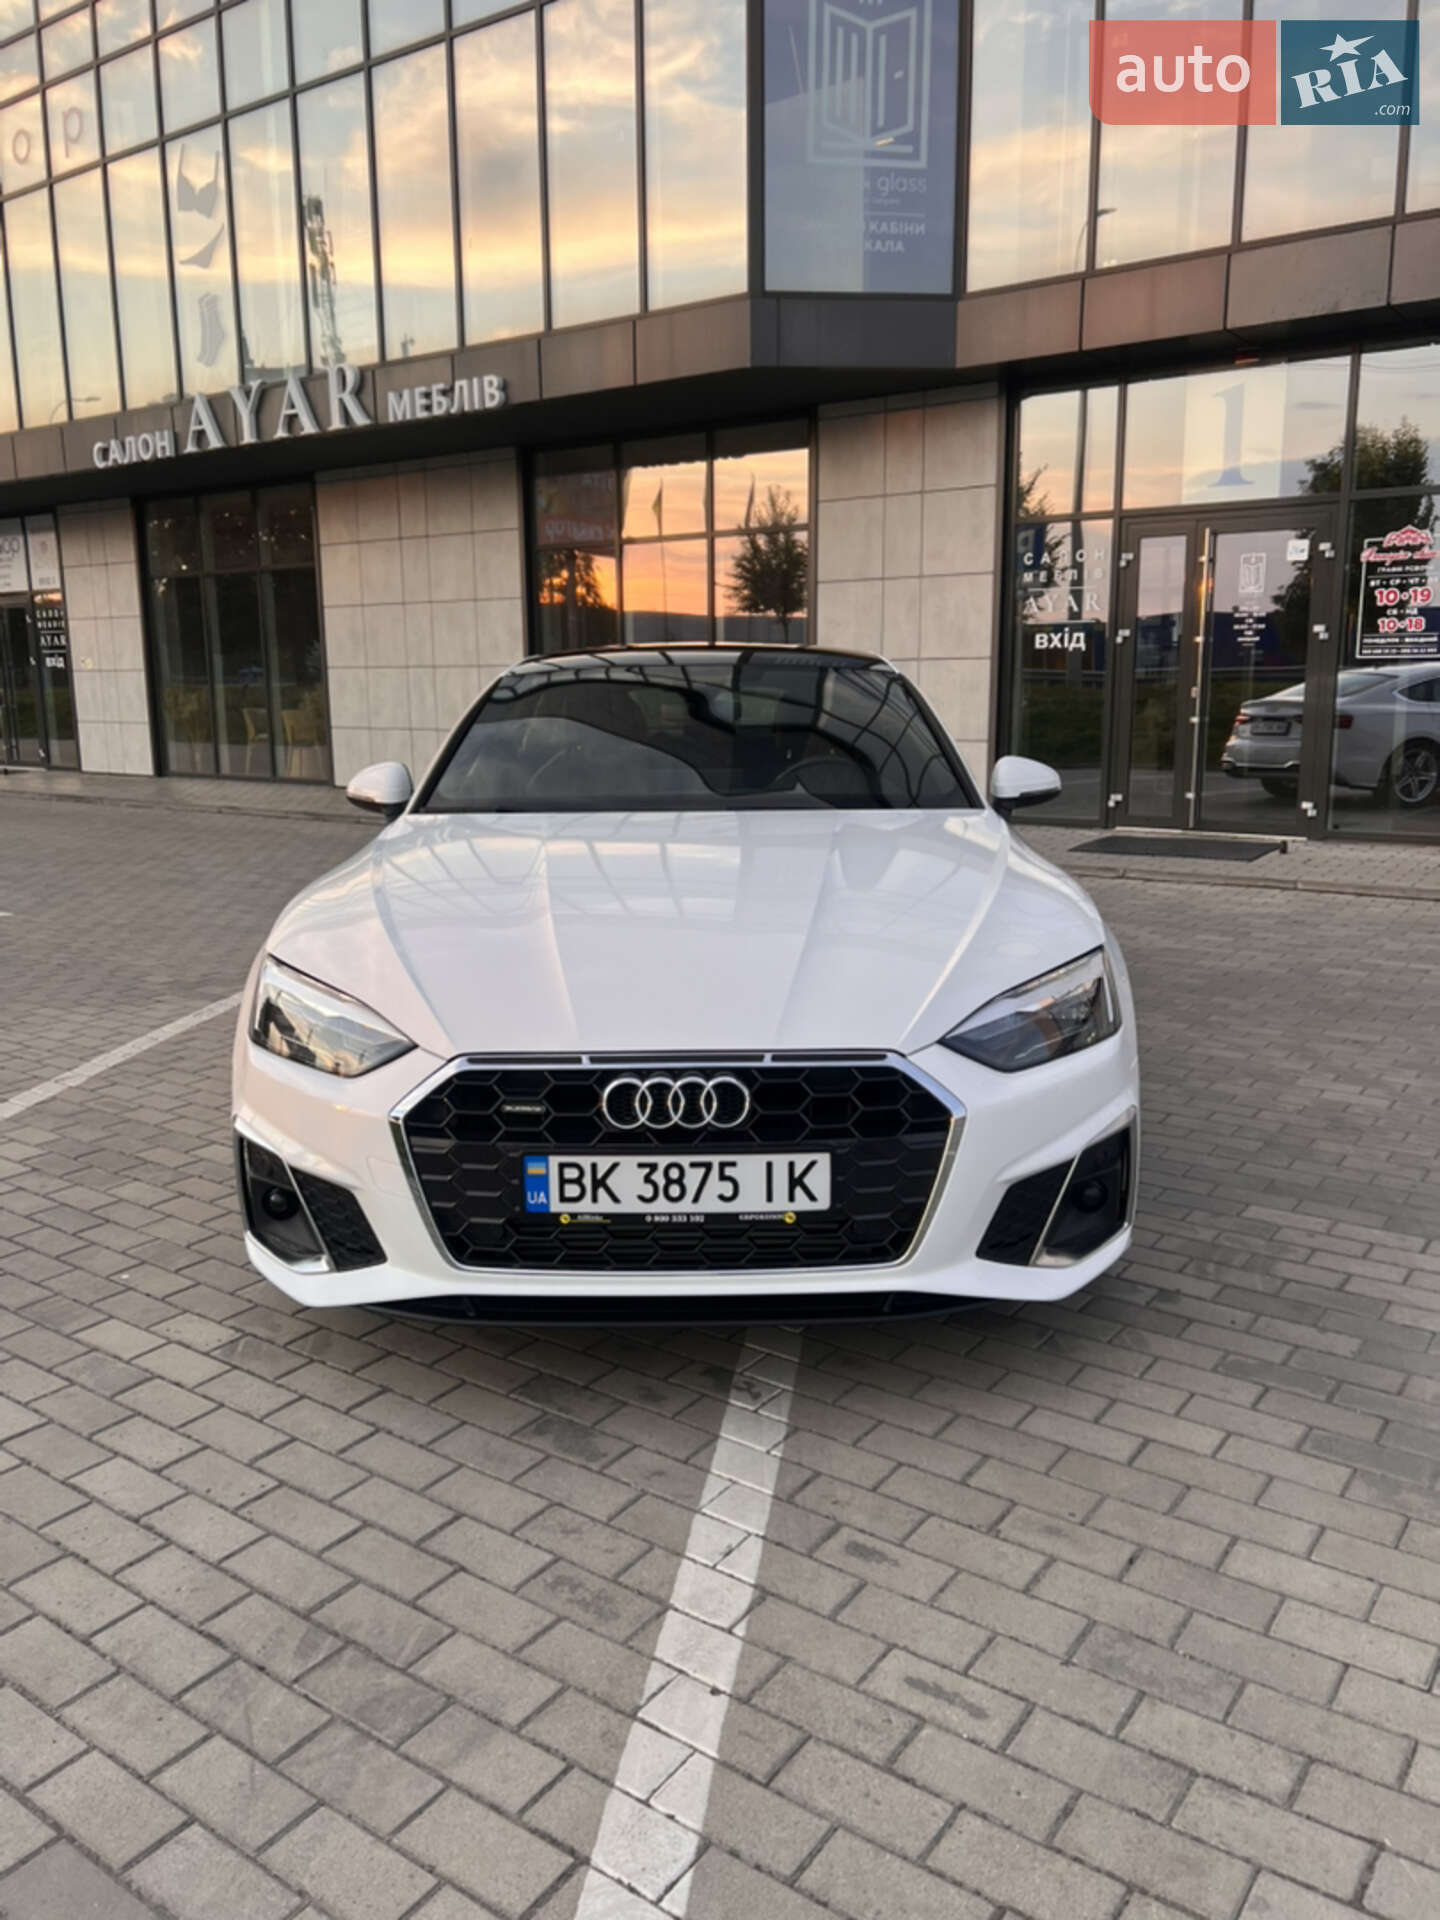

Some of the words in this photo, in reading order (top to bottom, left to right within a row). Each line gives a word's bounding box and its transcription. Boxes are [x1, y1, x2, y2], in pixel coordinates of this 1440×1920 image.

[877, 172, 927, 196] glass
[869, 220, 926, 235] КАБІНИ
[93, 428, 174, 468] САЛОН
[183, 362, 375, 454] AYAR
[387, 373, 507, 423] МЕБЛІВ
[526, 1191, 548, 1205] UA
[557, 1161, 622, 1205] BK
[636, 1160, 741, 1205] 3875
[765, 1158, 819, 1204] IK
